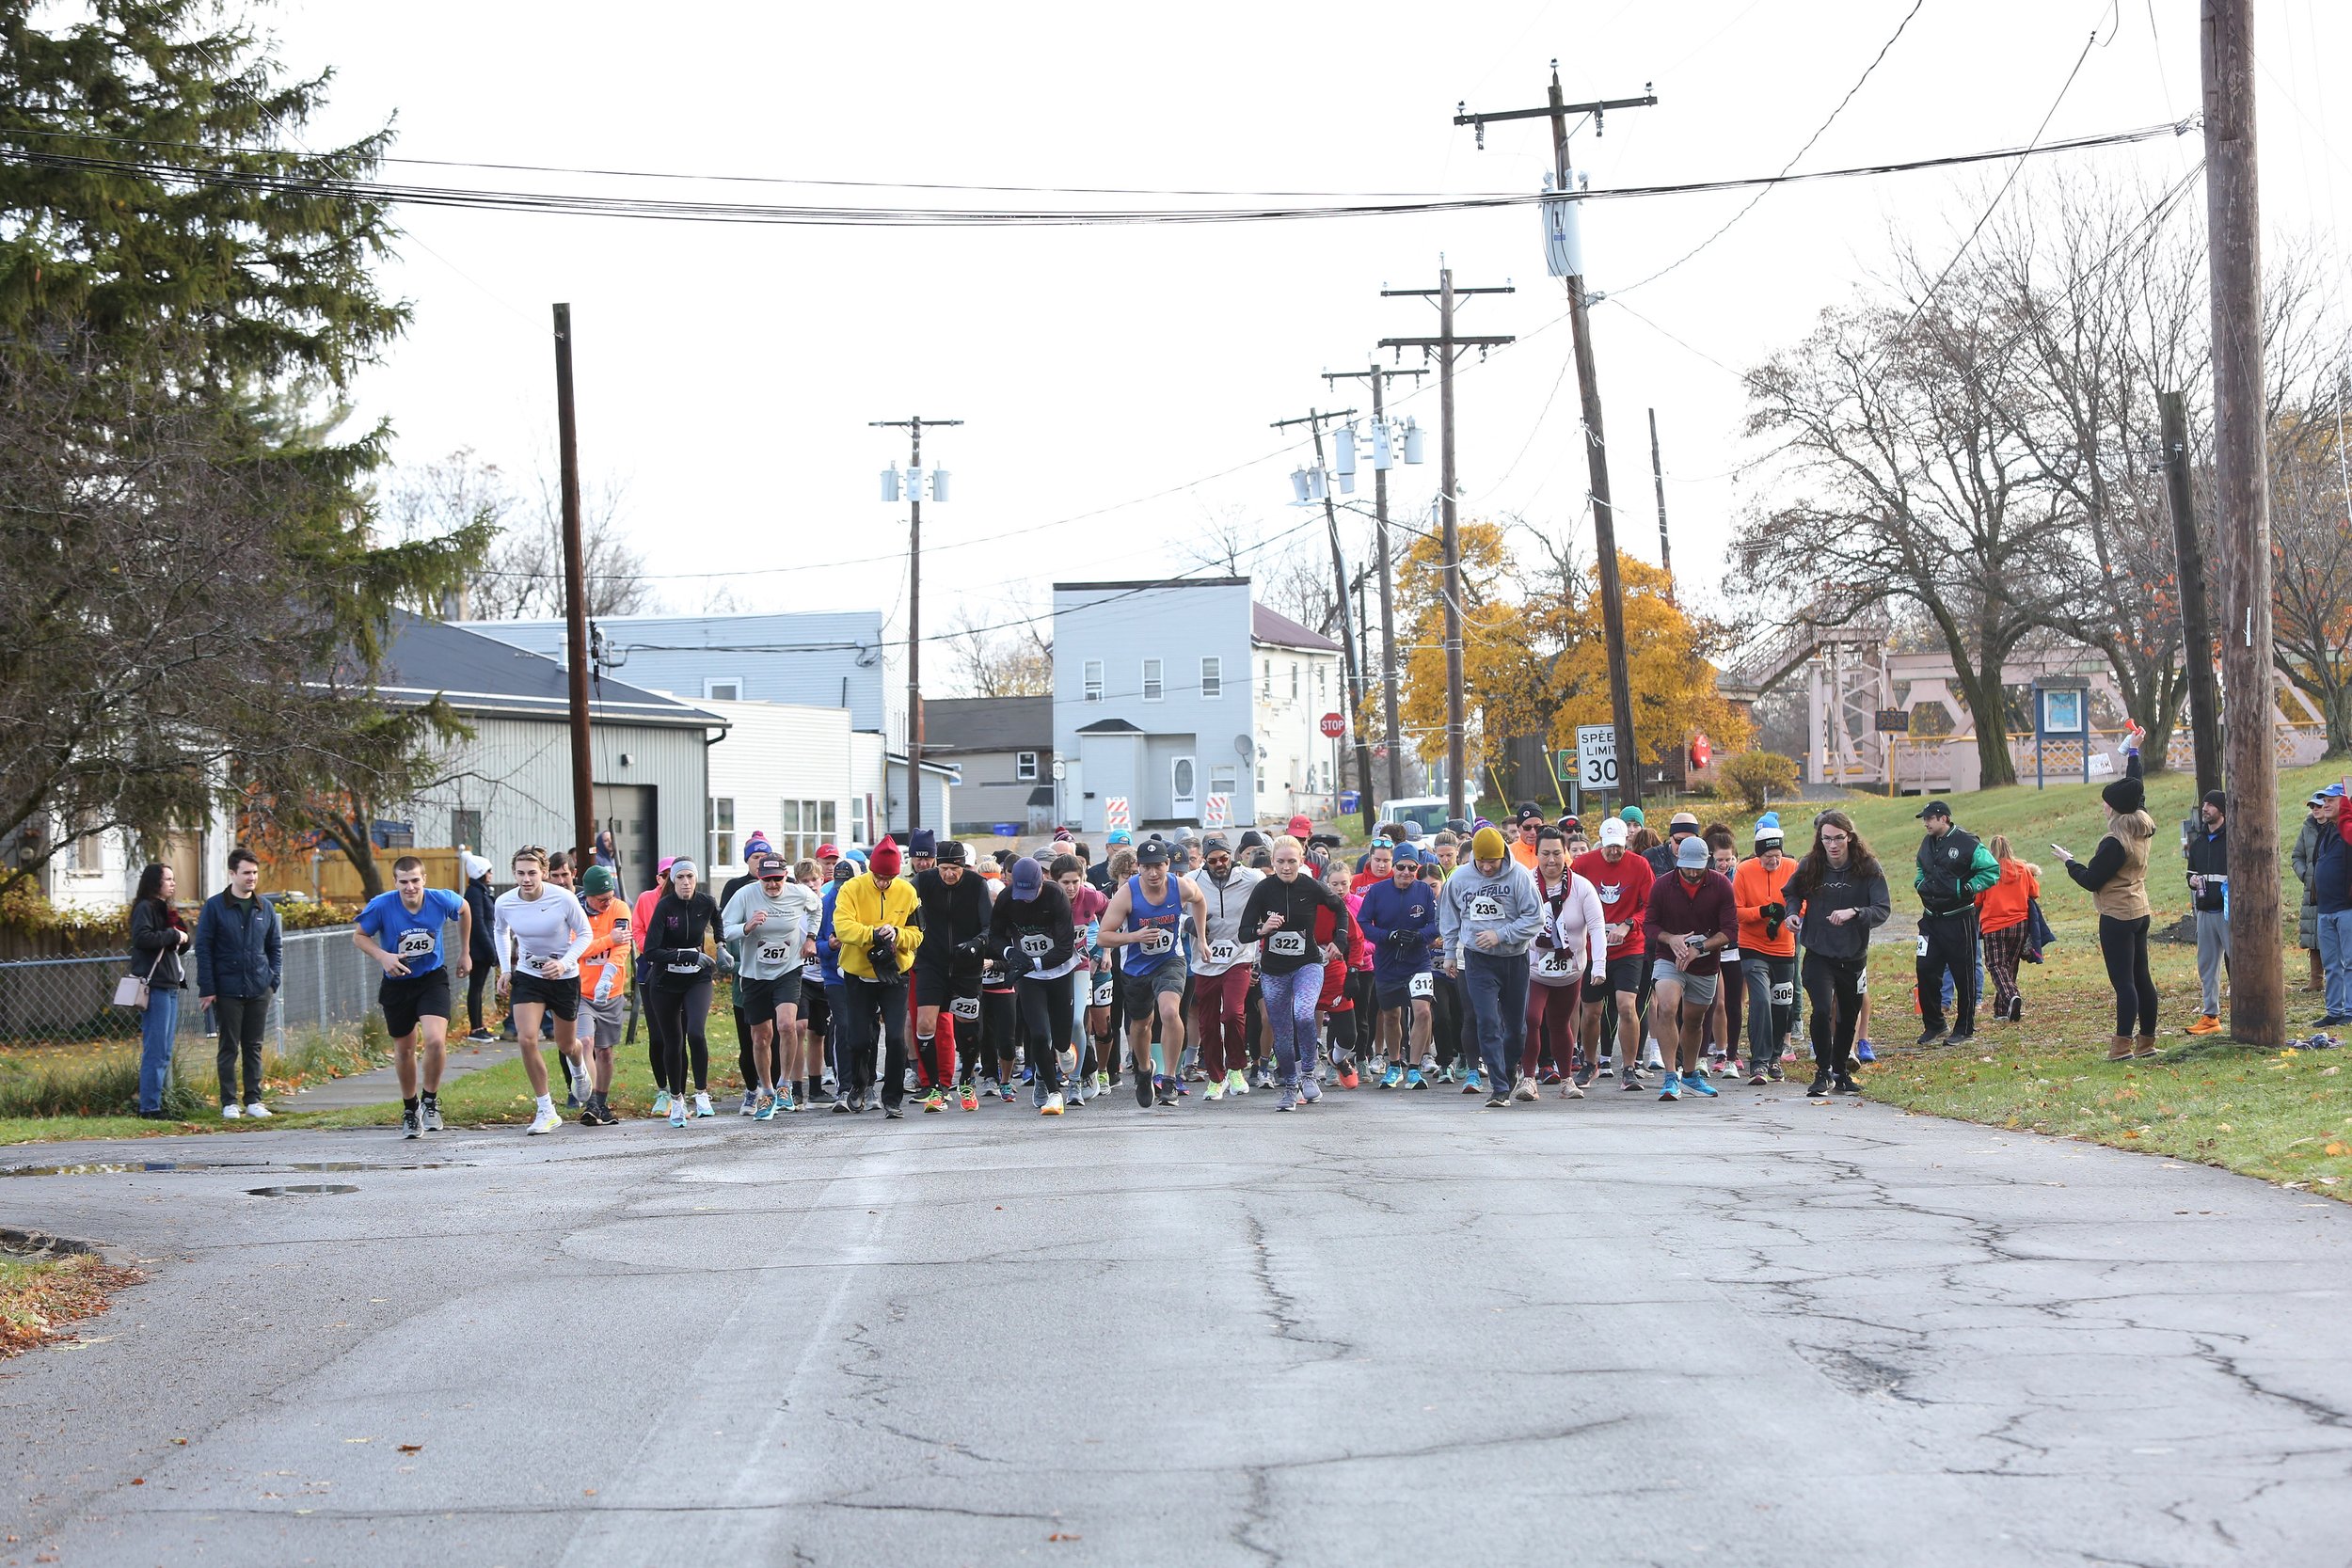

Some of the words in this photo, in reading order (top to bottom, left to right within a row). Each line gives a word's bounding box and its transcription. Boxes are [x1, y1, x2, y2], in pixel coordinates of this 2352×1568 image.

[1321, 720, 1344, 731] STOP
[1581, 733, 1614, 744] SPEE
[1588, 759, 1618, 783] 30
[1462, 885, 1510, 912] BFFALO
[1475, 903, 1498, 915] 235
[405, 940, 429, 952] 245
[1025, 941, 1048, 952] 318
[1275, 938, 1299, 950] 322
[763, 948, 787, 959] 267
[1212, 946, 1233, 958] 247
[1545, 959, 1568, 972] 236
[1099, 989, 1113, 1000] 27
[1773, 988, 1793, 1000] 309
[955, 1002, 977, 1015] 228
